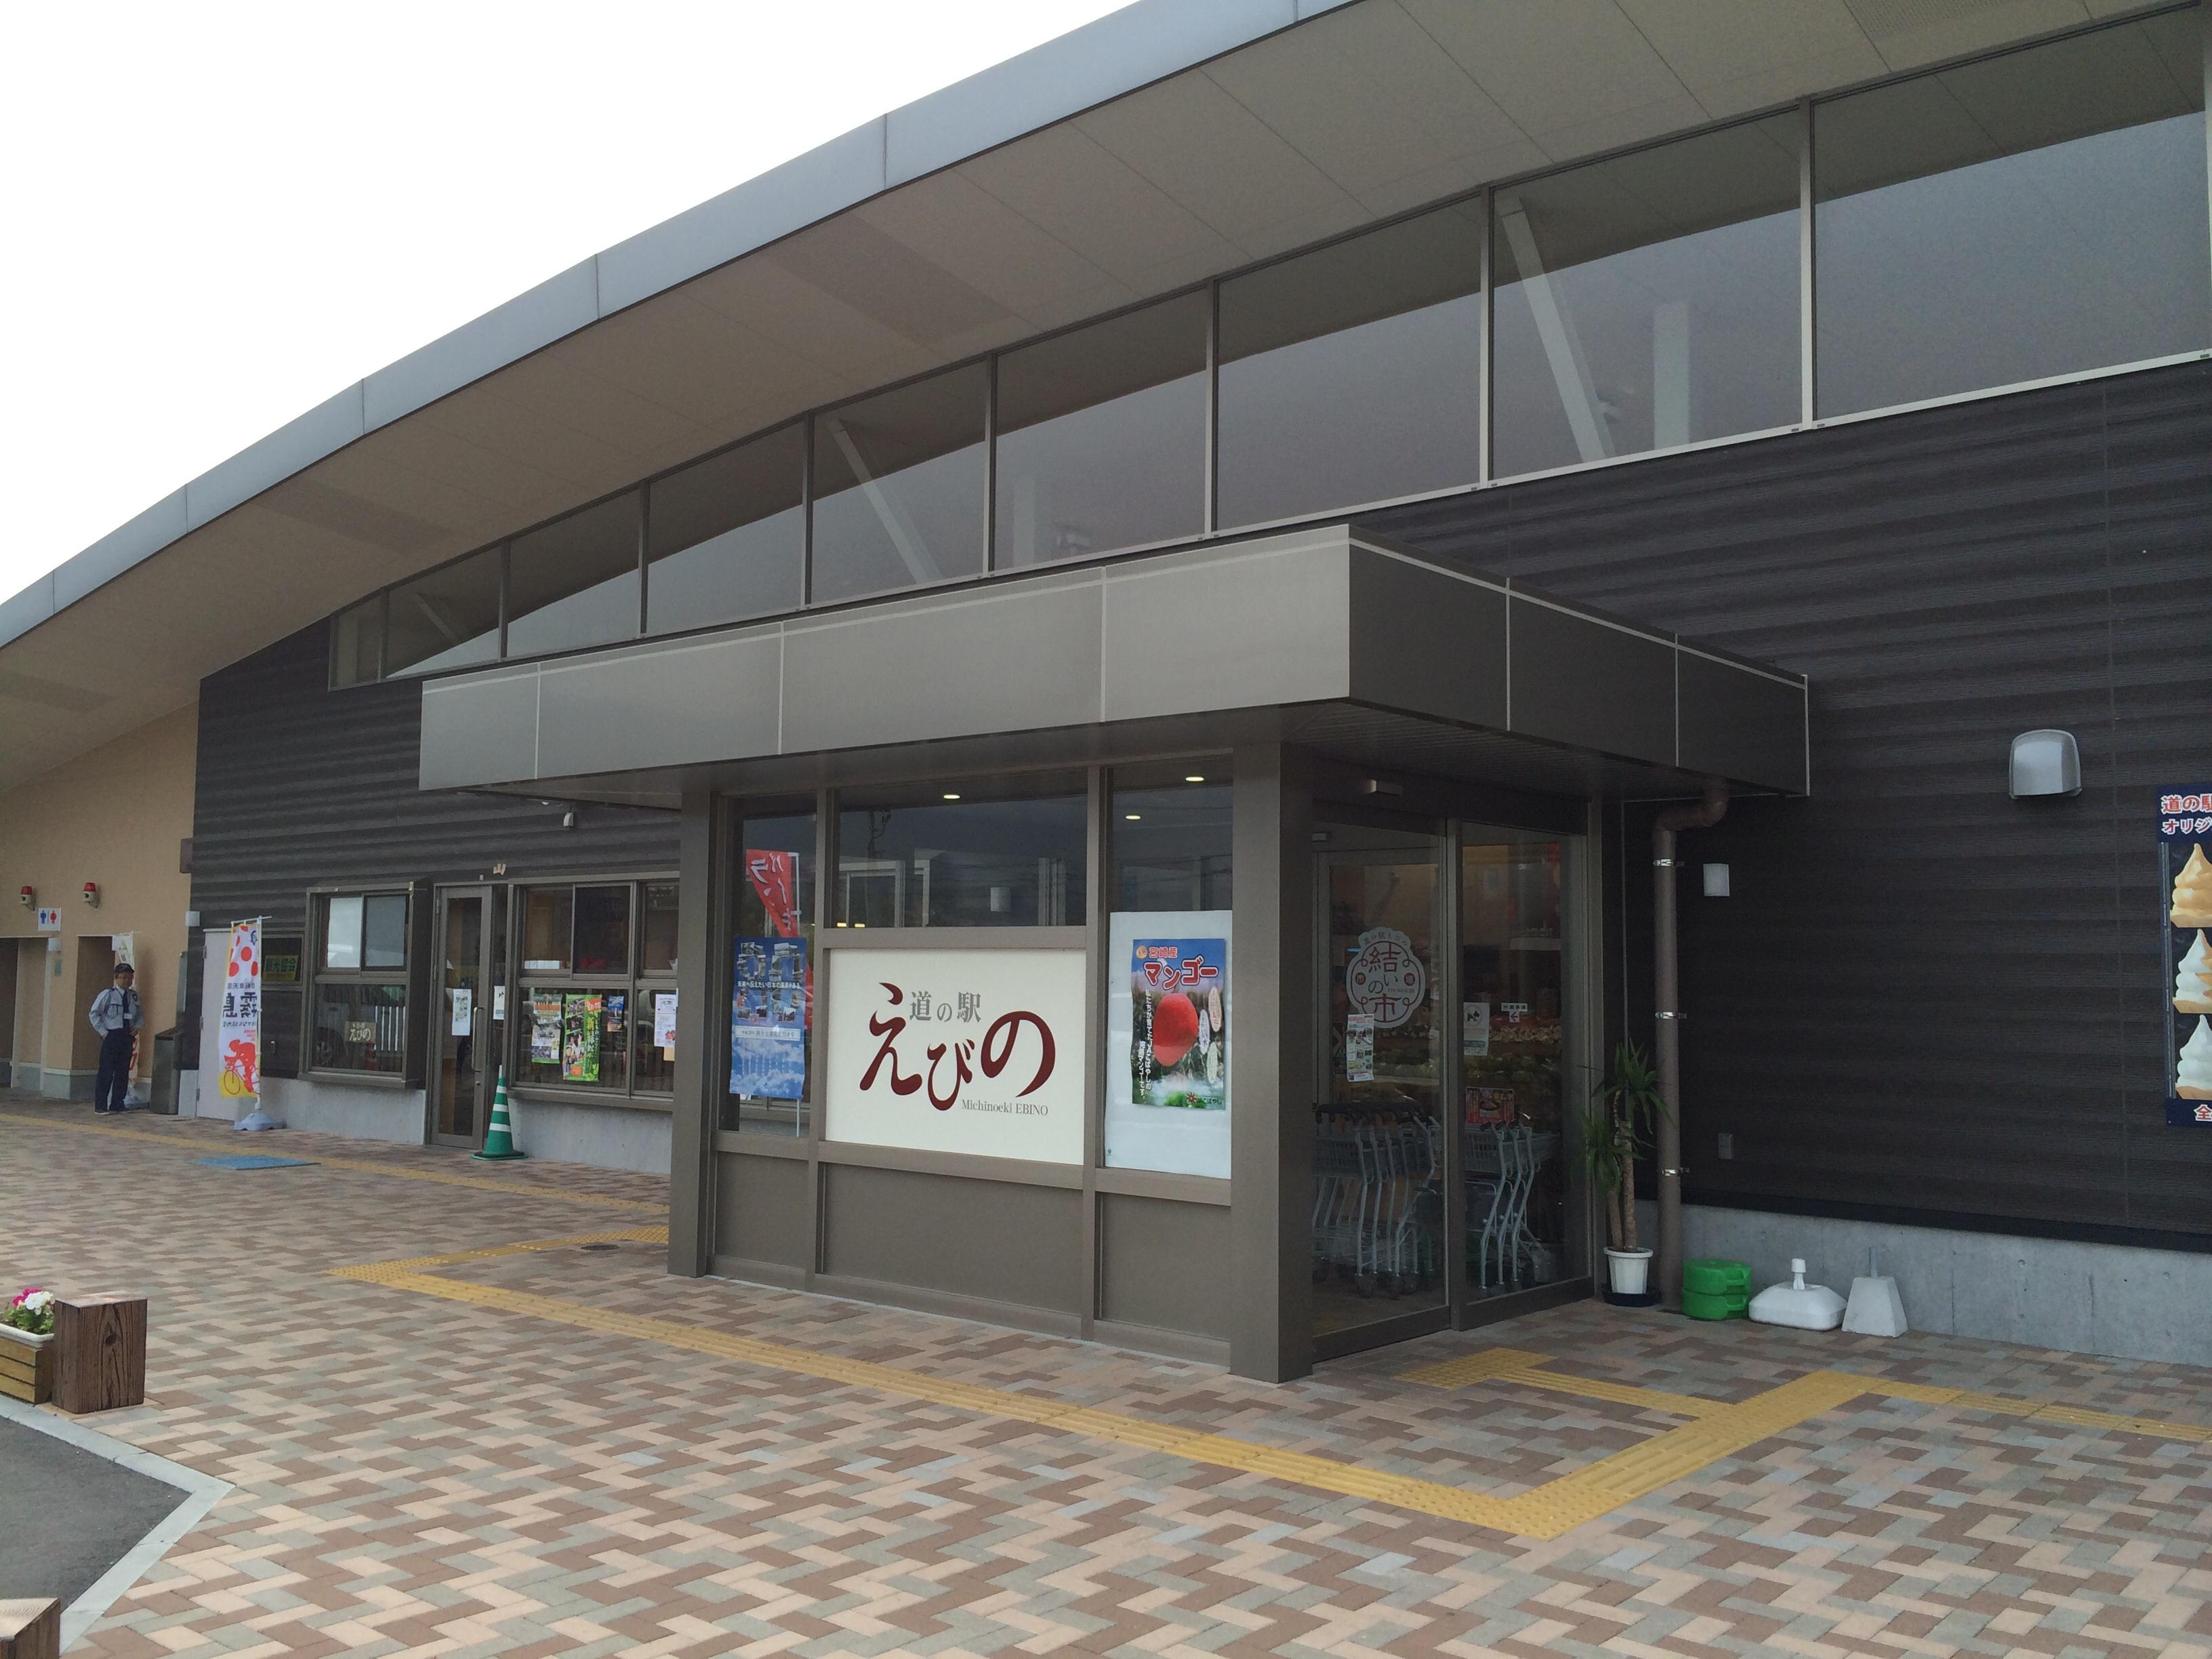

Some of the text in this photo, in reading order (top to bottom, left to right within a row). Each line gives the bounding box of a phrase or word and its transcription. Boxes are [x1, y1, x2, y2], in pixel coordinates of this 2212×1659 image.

[2161, 817, 2212, 835] オリジ
[1149, 945, 1178, 959] 宮崎産
[1143, 956, 1218, 991] マンゴー
[909, 991, 982, 1024] 道の駅
[859, 982, 1056, 1111] えびの
[962, 1099, 1048, 1116] Michinoeki EBINO
